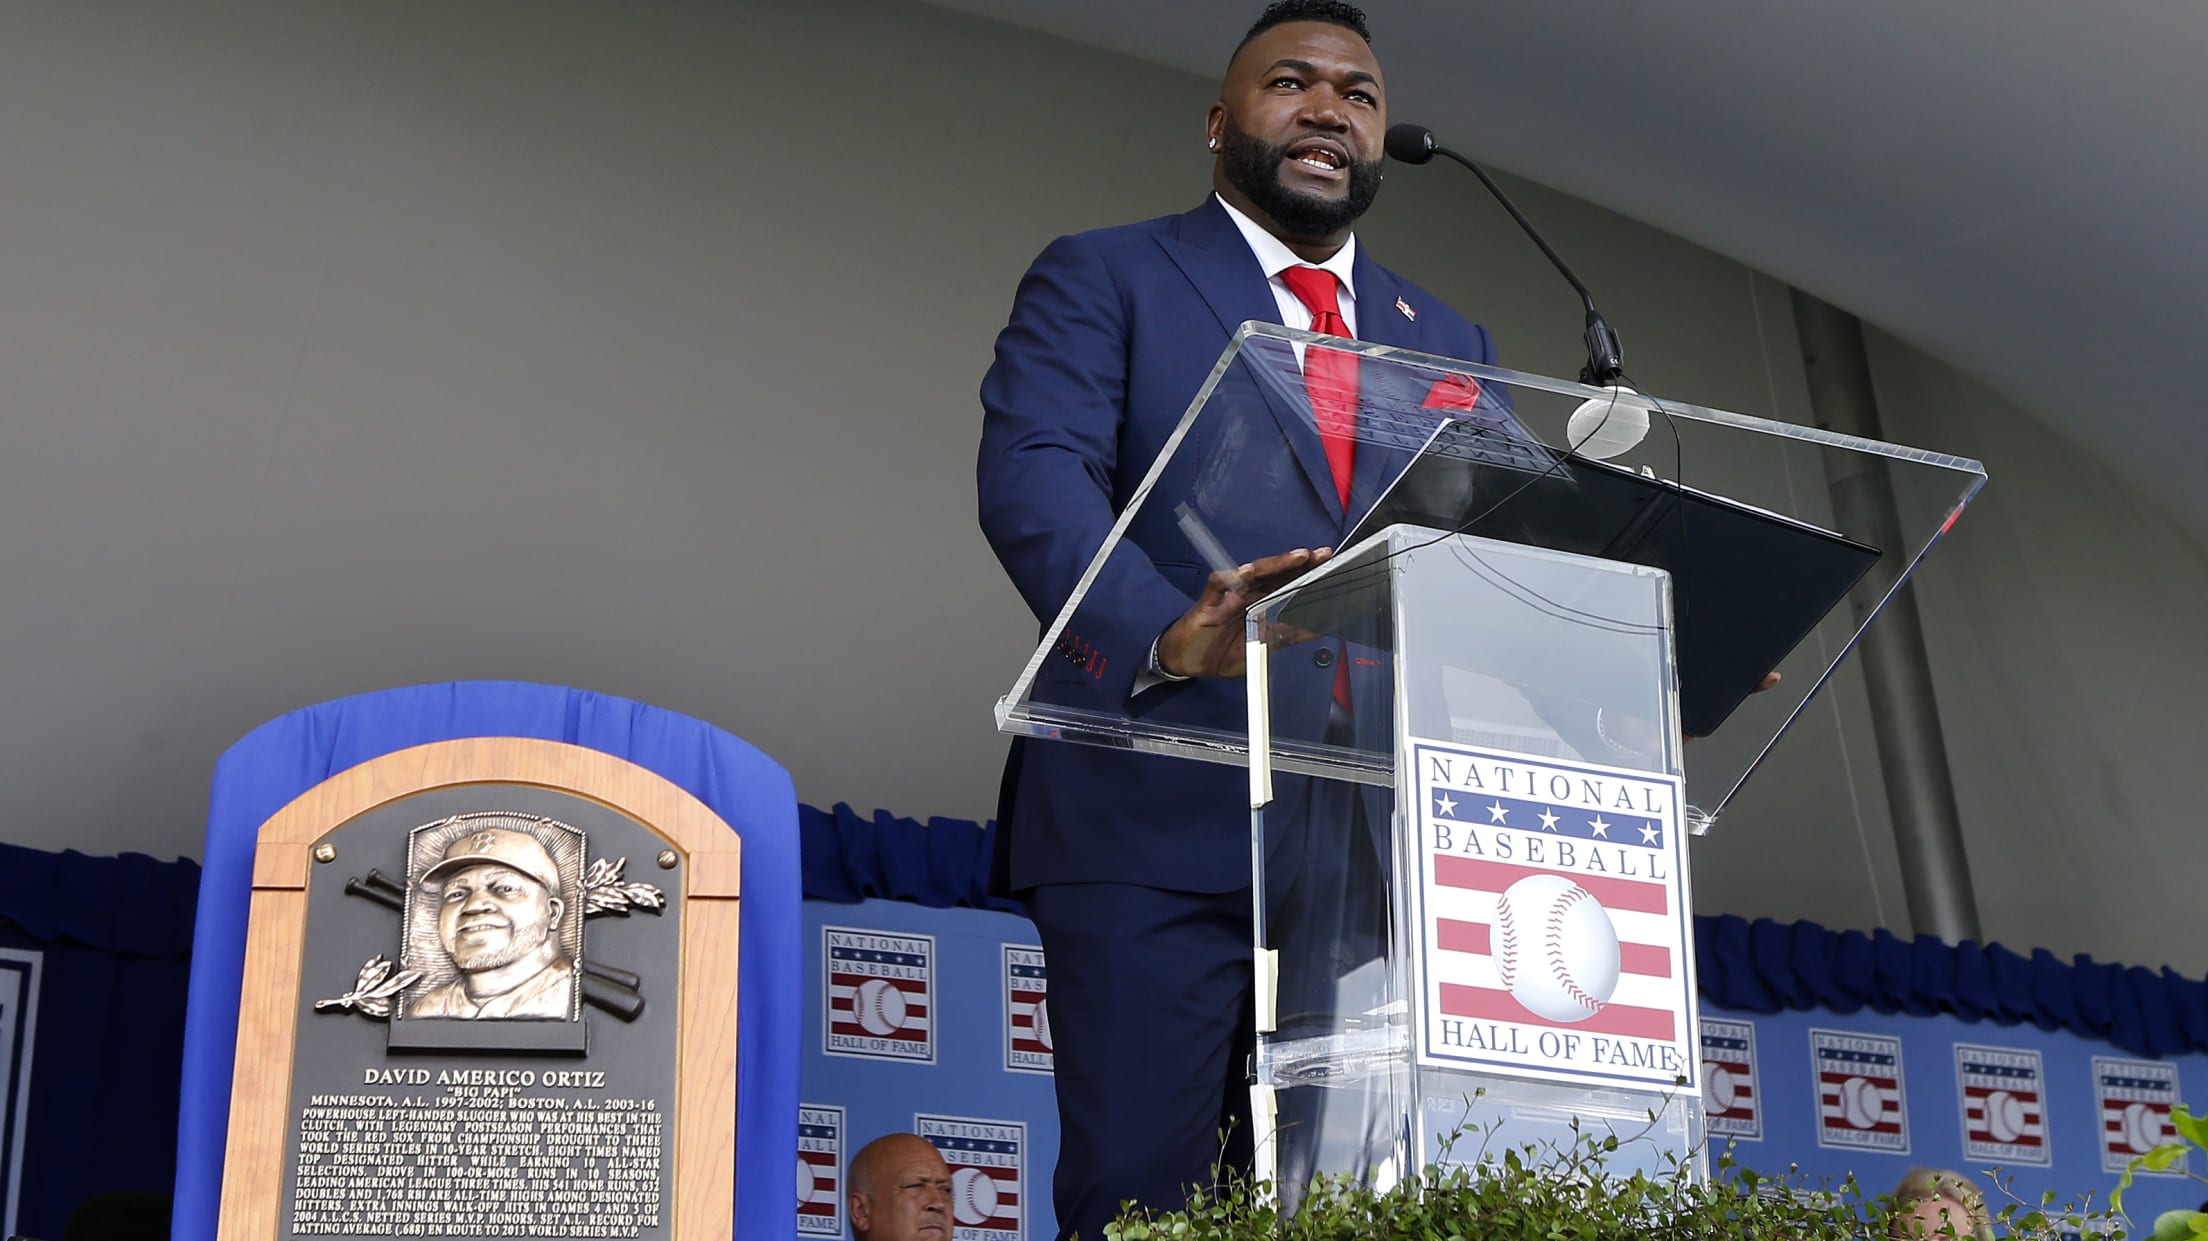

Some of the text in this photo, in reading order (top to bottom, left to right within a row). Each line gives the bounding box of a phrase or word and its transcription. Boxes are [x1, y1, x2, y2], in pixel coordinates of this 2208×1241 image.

[1429, 756, 1663, 814] NATIONAL
[1432, 824, 1667, 880] BASEBALL
[830, 934, 927, 954] NATIONAL
[831, 960, 927, 980] BASEBALL
[1701, 1024, 1749, 1038] IONAL
[831, 1035, 928, 1055] HALL OF FAME
[1440, 1019, 1679, 1073] HALL OF FAME
[1012, 1052, 1047, 1066] HALL
[364, 1069, 605, 1088] DAVID AMERICO ORTIZ
[311, 1095, 655, 1111] MINNESOTA, A.L. 1997-2002; BOSTON, A.L. 2003-16
[302, 1109, 662, 1123] POWERHOUSE LEFT-HANDED SLUGGER WHO WAS AT HIS BEST IN THE
[301, 1120, 662, 1135] CLUTCH, WITH LEGENDARY POSTSEASON PERFORMANCES THAT
[922, 1121, 1019, 1141] NATIONAL
[301, 1131, 661, 1145] TOOK THE RED SOX FROM CHAMPIONSHIP DROUGHT TO THREE
[300, 1143, 661, 1158] WORLD SERIES TITLES IN 10-YEAR STRETCH. EIGHT TIMES NAMED
[299, 1154, 660, 1169] TOP DESIGNATED HITTER WHILE EARNING 10 ALL-STAR
[947, 1151, 1019, 1167] SEBALL
[297, 1166, 660, 1180] SELECTIONS. DROVE IN 100-OR-MORE RUNS IN 10 SEASONS,
[297, 1177, 659, 1192] LEADING AMERICAN LEAGUE THREE TIMES. HIS 541 HOME RUNS, 632
[296, 1189, 659, 1203] DOUBLES AND 1,768 RBI ARE ALL-TIME HIGHS AMONG DESIGNATED
[295, 1200, 659, 1215] HITTERS. EXTRA INNINGS WALK-OFF HITS IN GAMES 4 AND 5 OF
[293, 1212, 659, 1226] 2004 A.L.C.S. NETTED SERIES M.V.P. HONORS. SET A.L. RECORD FOR
[799, 1215, 837, 1230] FAME
[292, 1223, 639, 1238] BATTING AVERAGE (.688) EN ROUTE TO 2013 WORLD SERIES M.V.P.
[962, 1229, 979, 1241] OF
